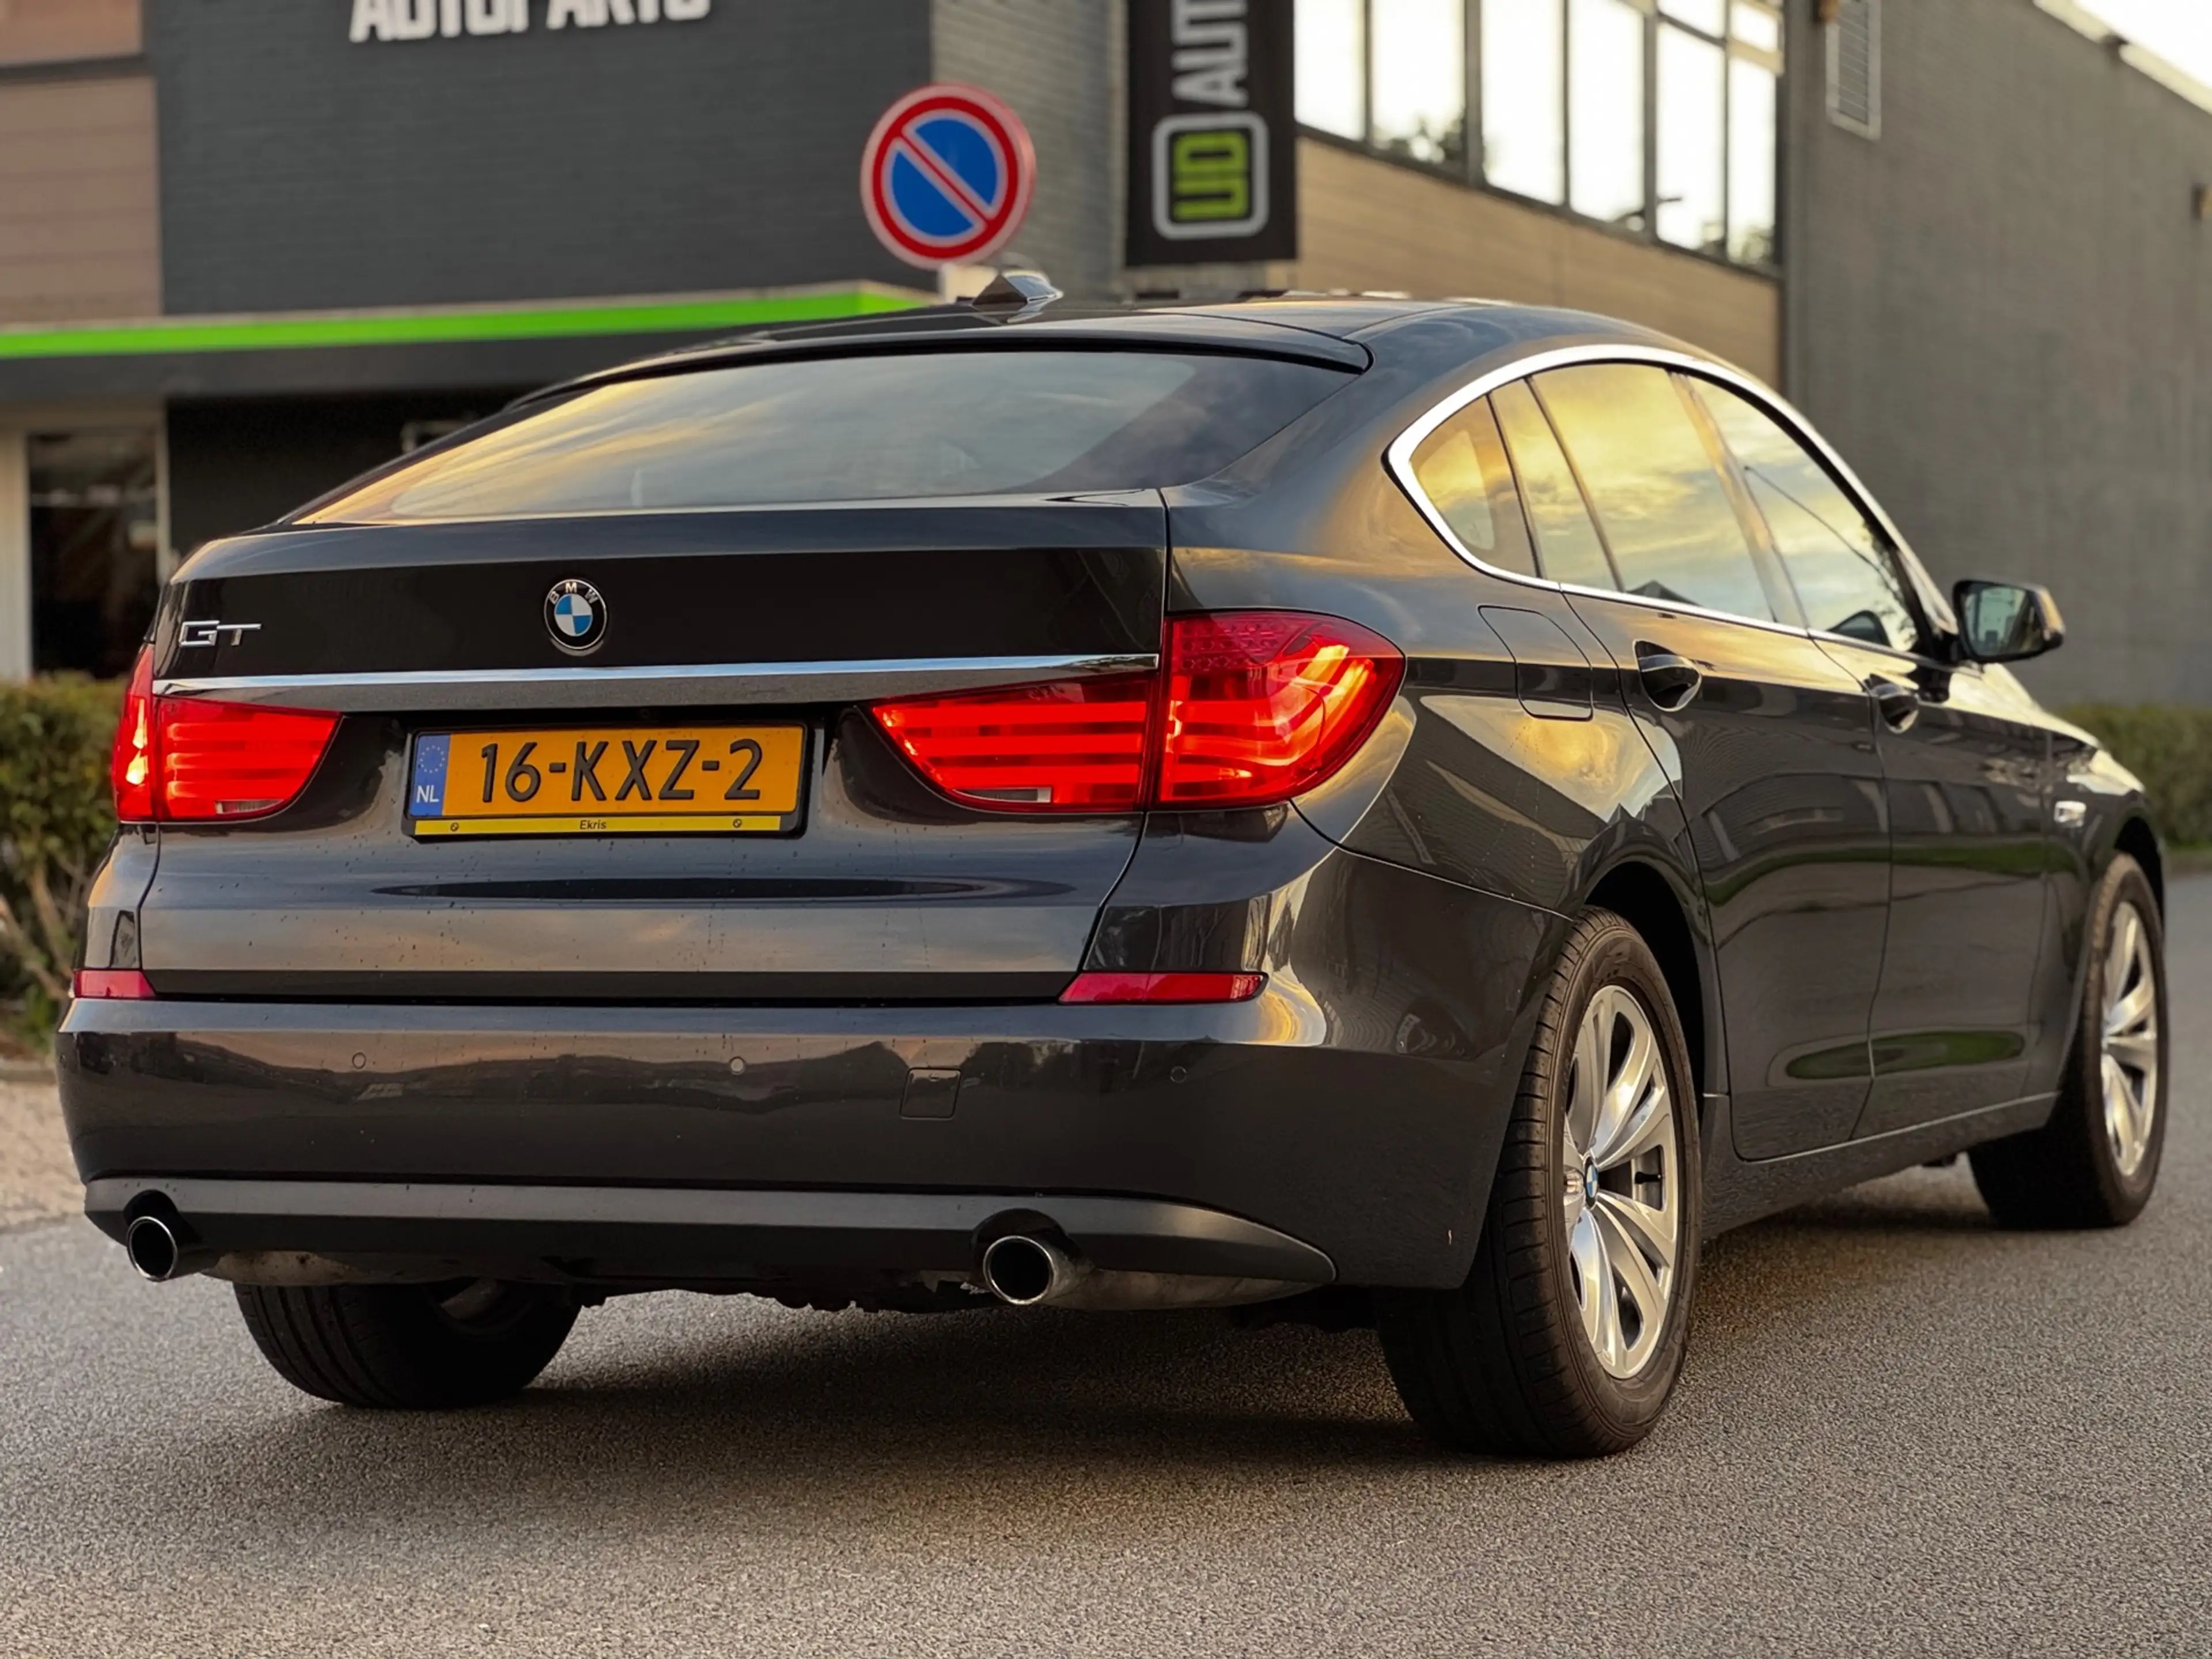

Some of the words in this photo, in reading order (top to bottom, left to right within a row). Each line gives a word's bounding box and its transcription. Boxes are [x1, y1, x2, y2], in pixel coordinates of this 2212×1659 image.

[548, 582, 599, 605] BMW
[179, 620, 262, 646] GT
[480, 738, 763, 803] 16-KXZ-2
[416, 784, 440, 804] NL
[579, 819, 607, 830] Ekris
